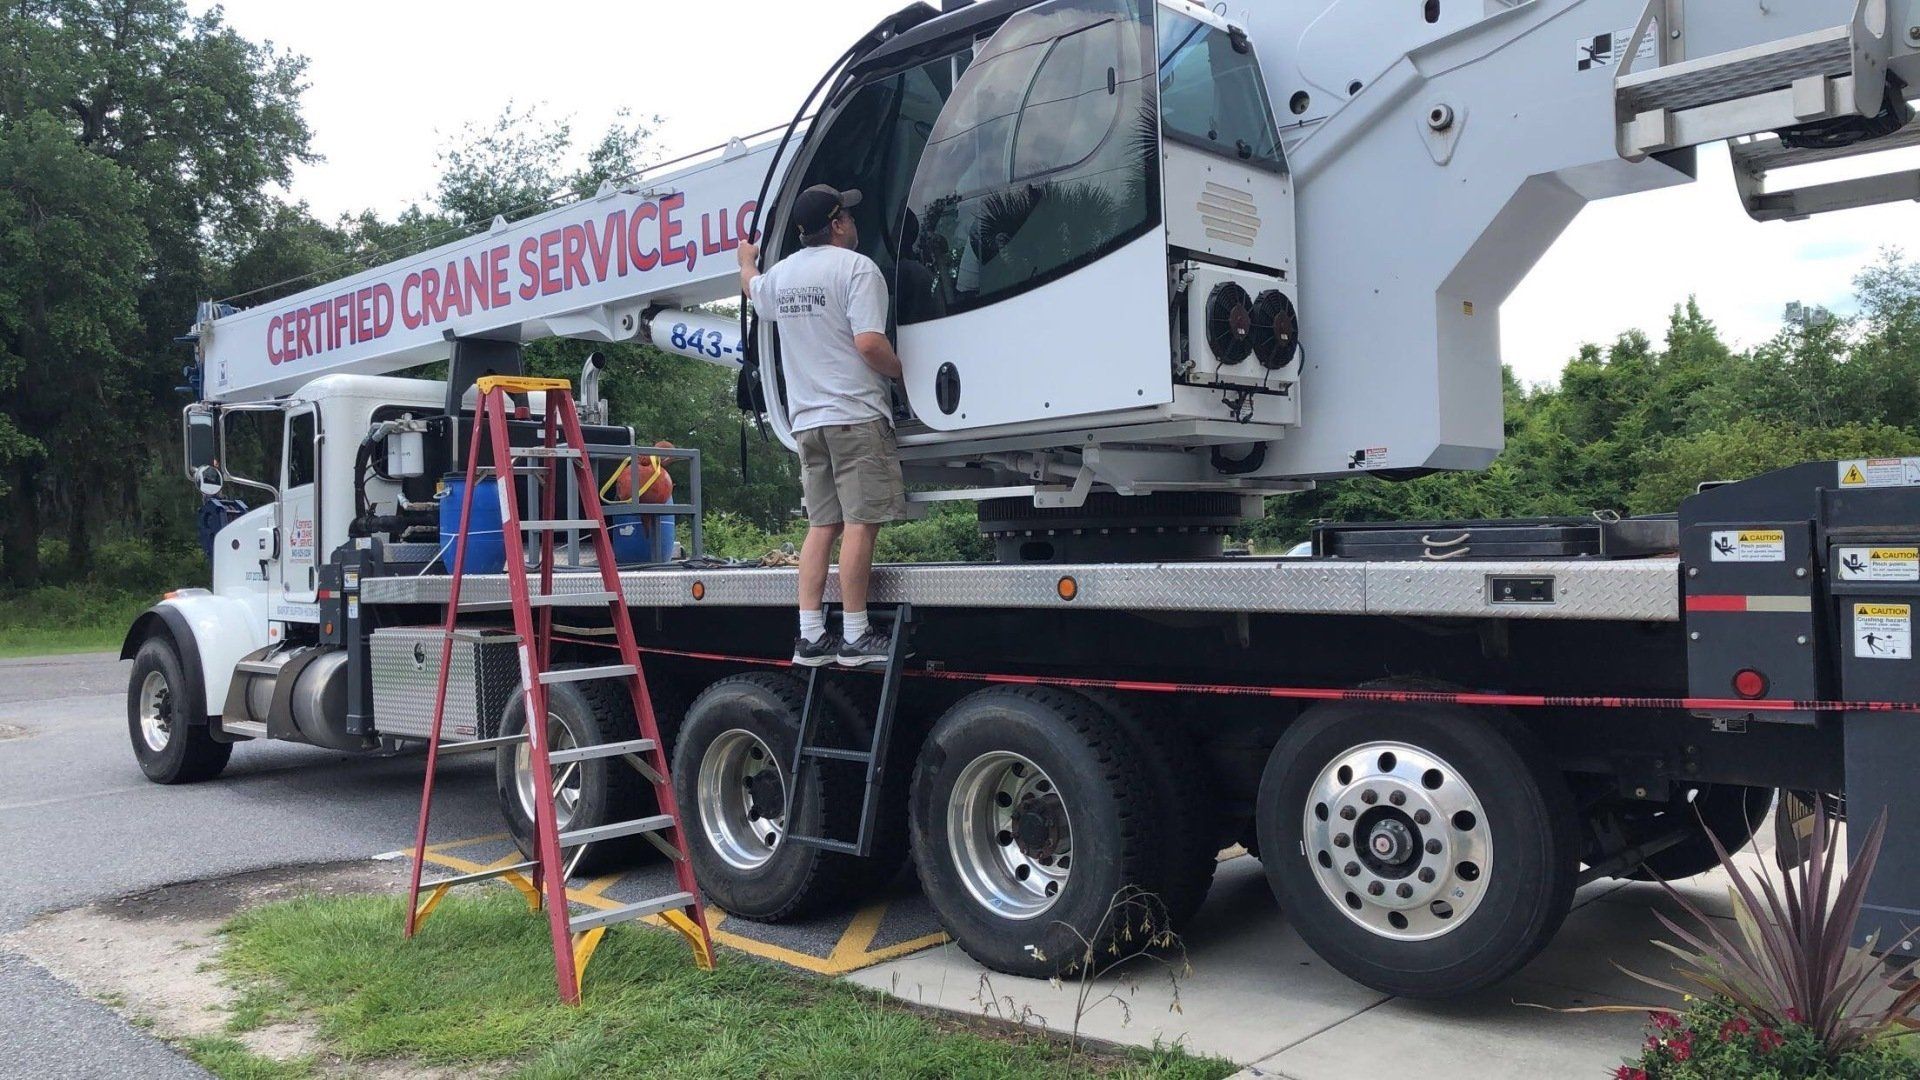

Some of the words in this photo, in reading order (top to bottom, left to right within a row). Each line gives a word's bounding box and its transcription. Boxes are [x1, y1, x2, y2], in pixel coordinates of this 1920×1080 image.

[267, 282, 394, 366] CERTIFIED
[401, 244, 511, 330] CRANE
[518, 192, 698, 301] SERVICE,
[701, 200, 762, 256] LLC
[799, 295, 826, 307] TINTING
[1870, 607, 1908, 615] CAUTION
